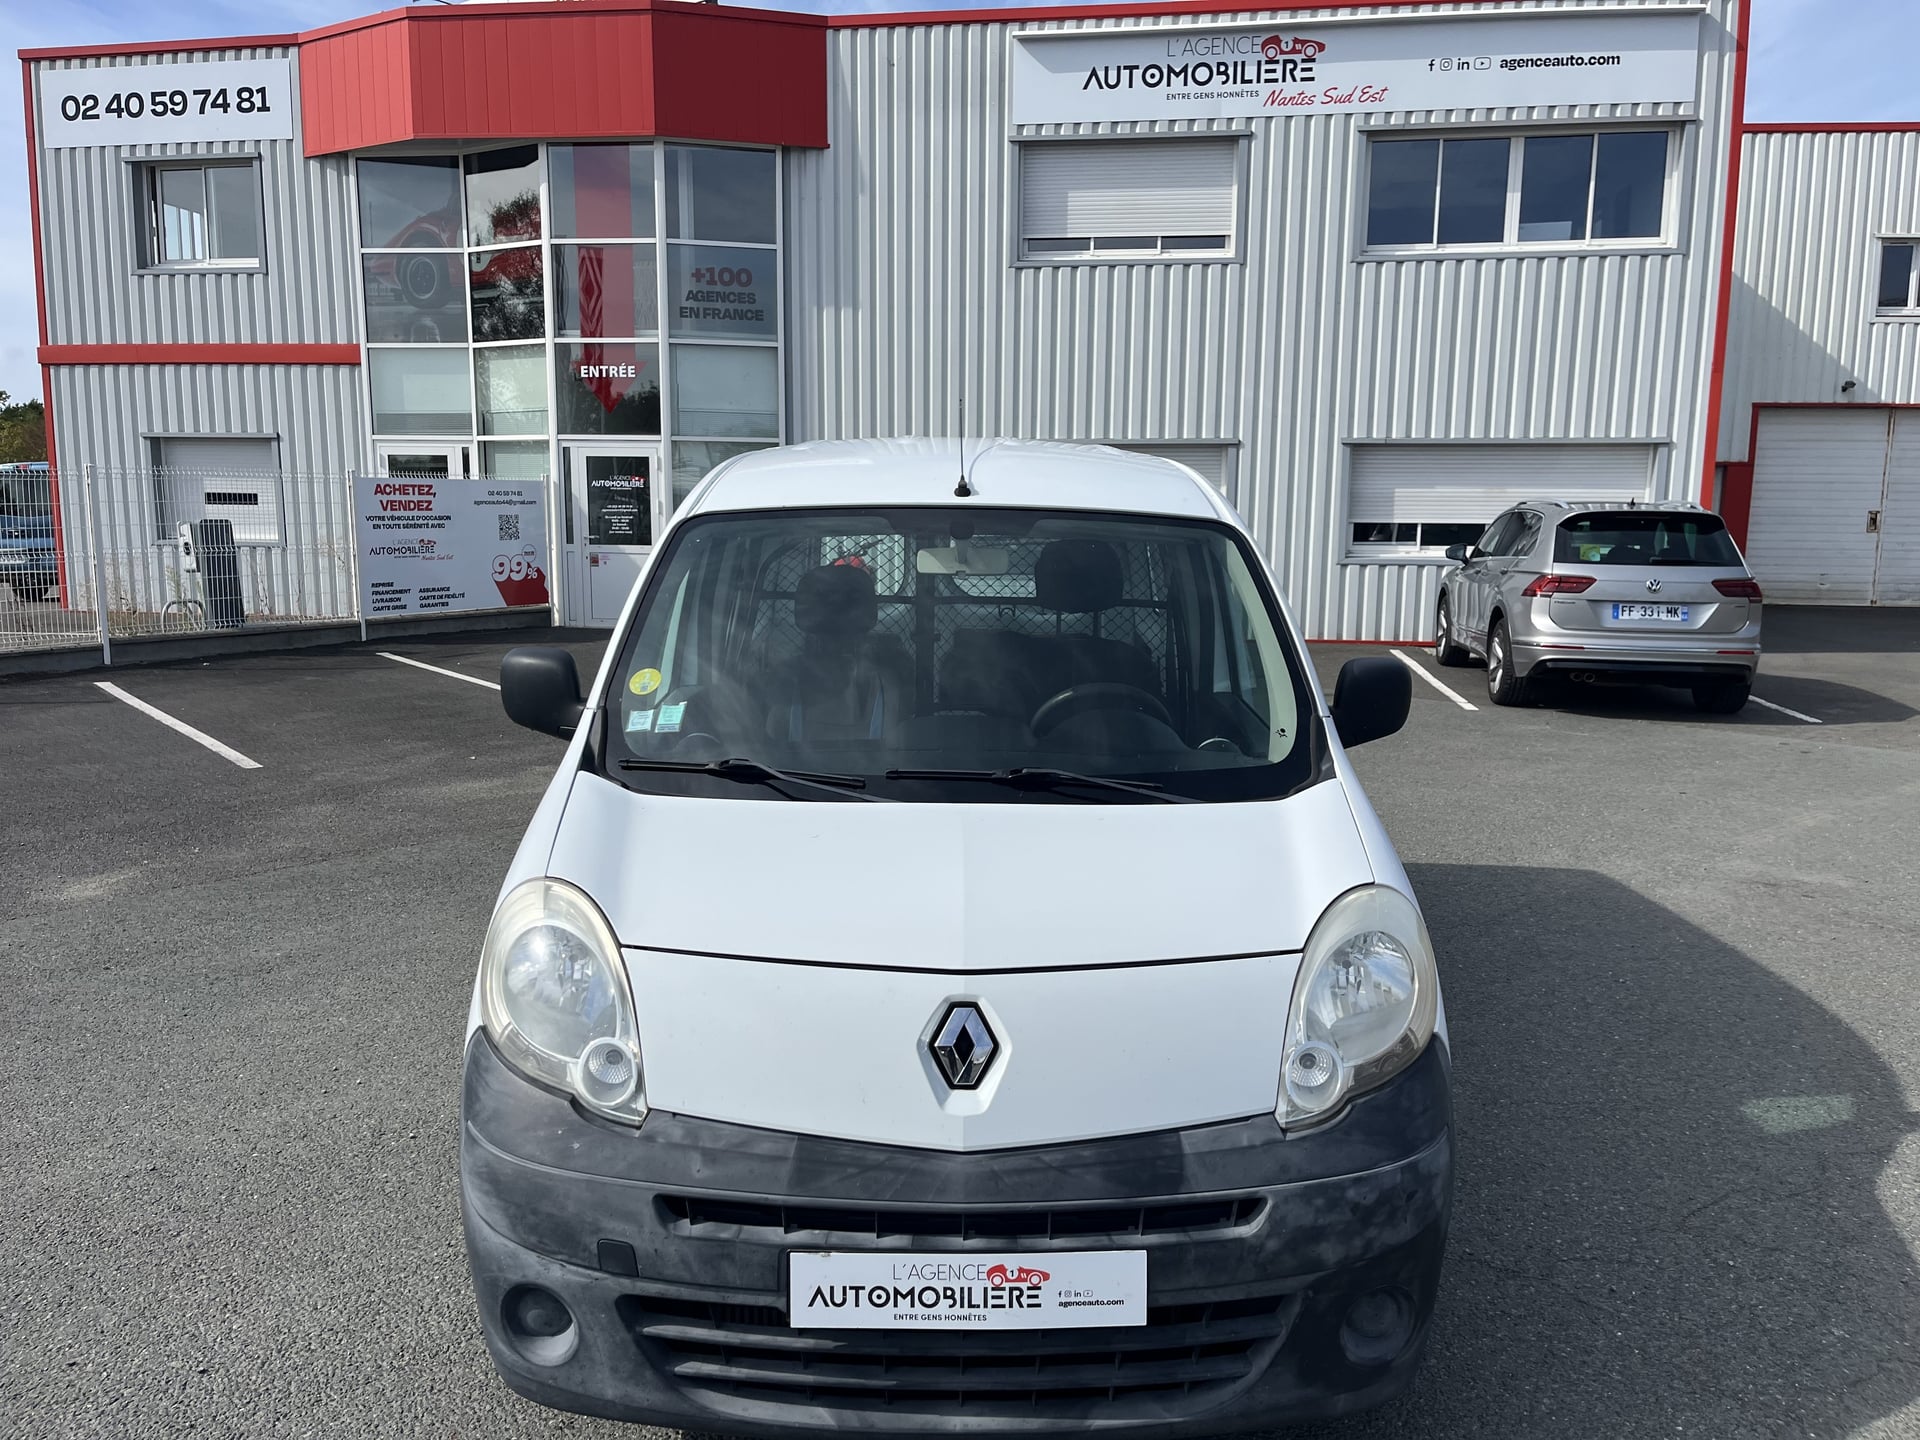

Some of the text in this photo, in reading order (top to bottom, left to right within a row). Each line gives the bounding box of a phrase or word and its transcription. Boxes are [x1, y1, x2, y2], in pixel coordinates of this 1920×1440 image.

[1167, 35, 1262, 57] L'AGENCE
[1500, 55, 1621, 71] agenceauto.com
[1167, 90, 1260, 101] ENTRE GENS HONNÊTES
[1263, 85, 1389, 107] Nantes Sud Est
[61, 86, 271, 121] 02 40 59 74 81
[691, 267, 753, 288] +100
[685, 290, 757, 304] AGENCES
[679, 306, 764, 321] EN FRANCE
[580, 362, 636, 378] ENTRÉE
[374, 484, 437, 498] ACHETEZ,
[379, 500, 433, 511] VENDEZ
[372, 588, 411, 596] FINANCEMENT
[893, 1263, 987, 1281] L'AGENCE
[1058, 1299, 1124, 1308] agenceauto.com
[893, 1312, 987, 1322] ENTRE GENS HONNÊTES
